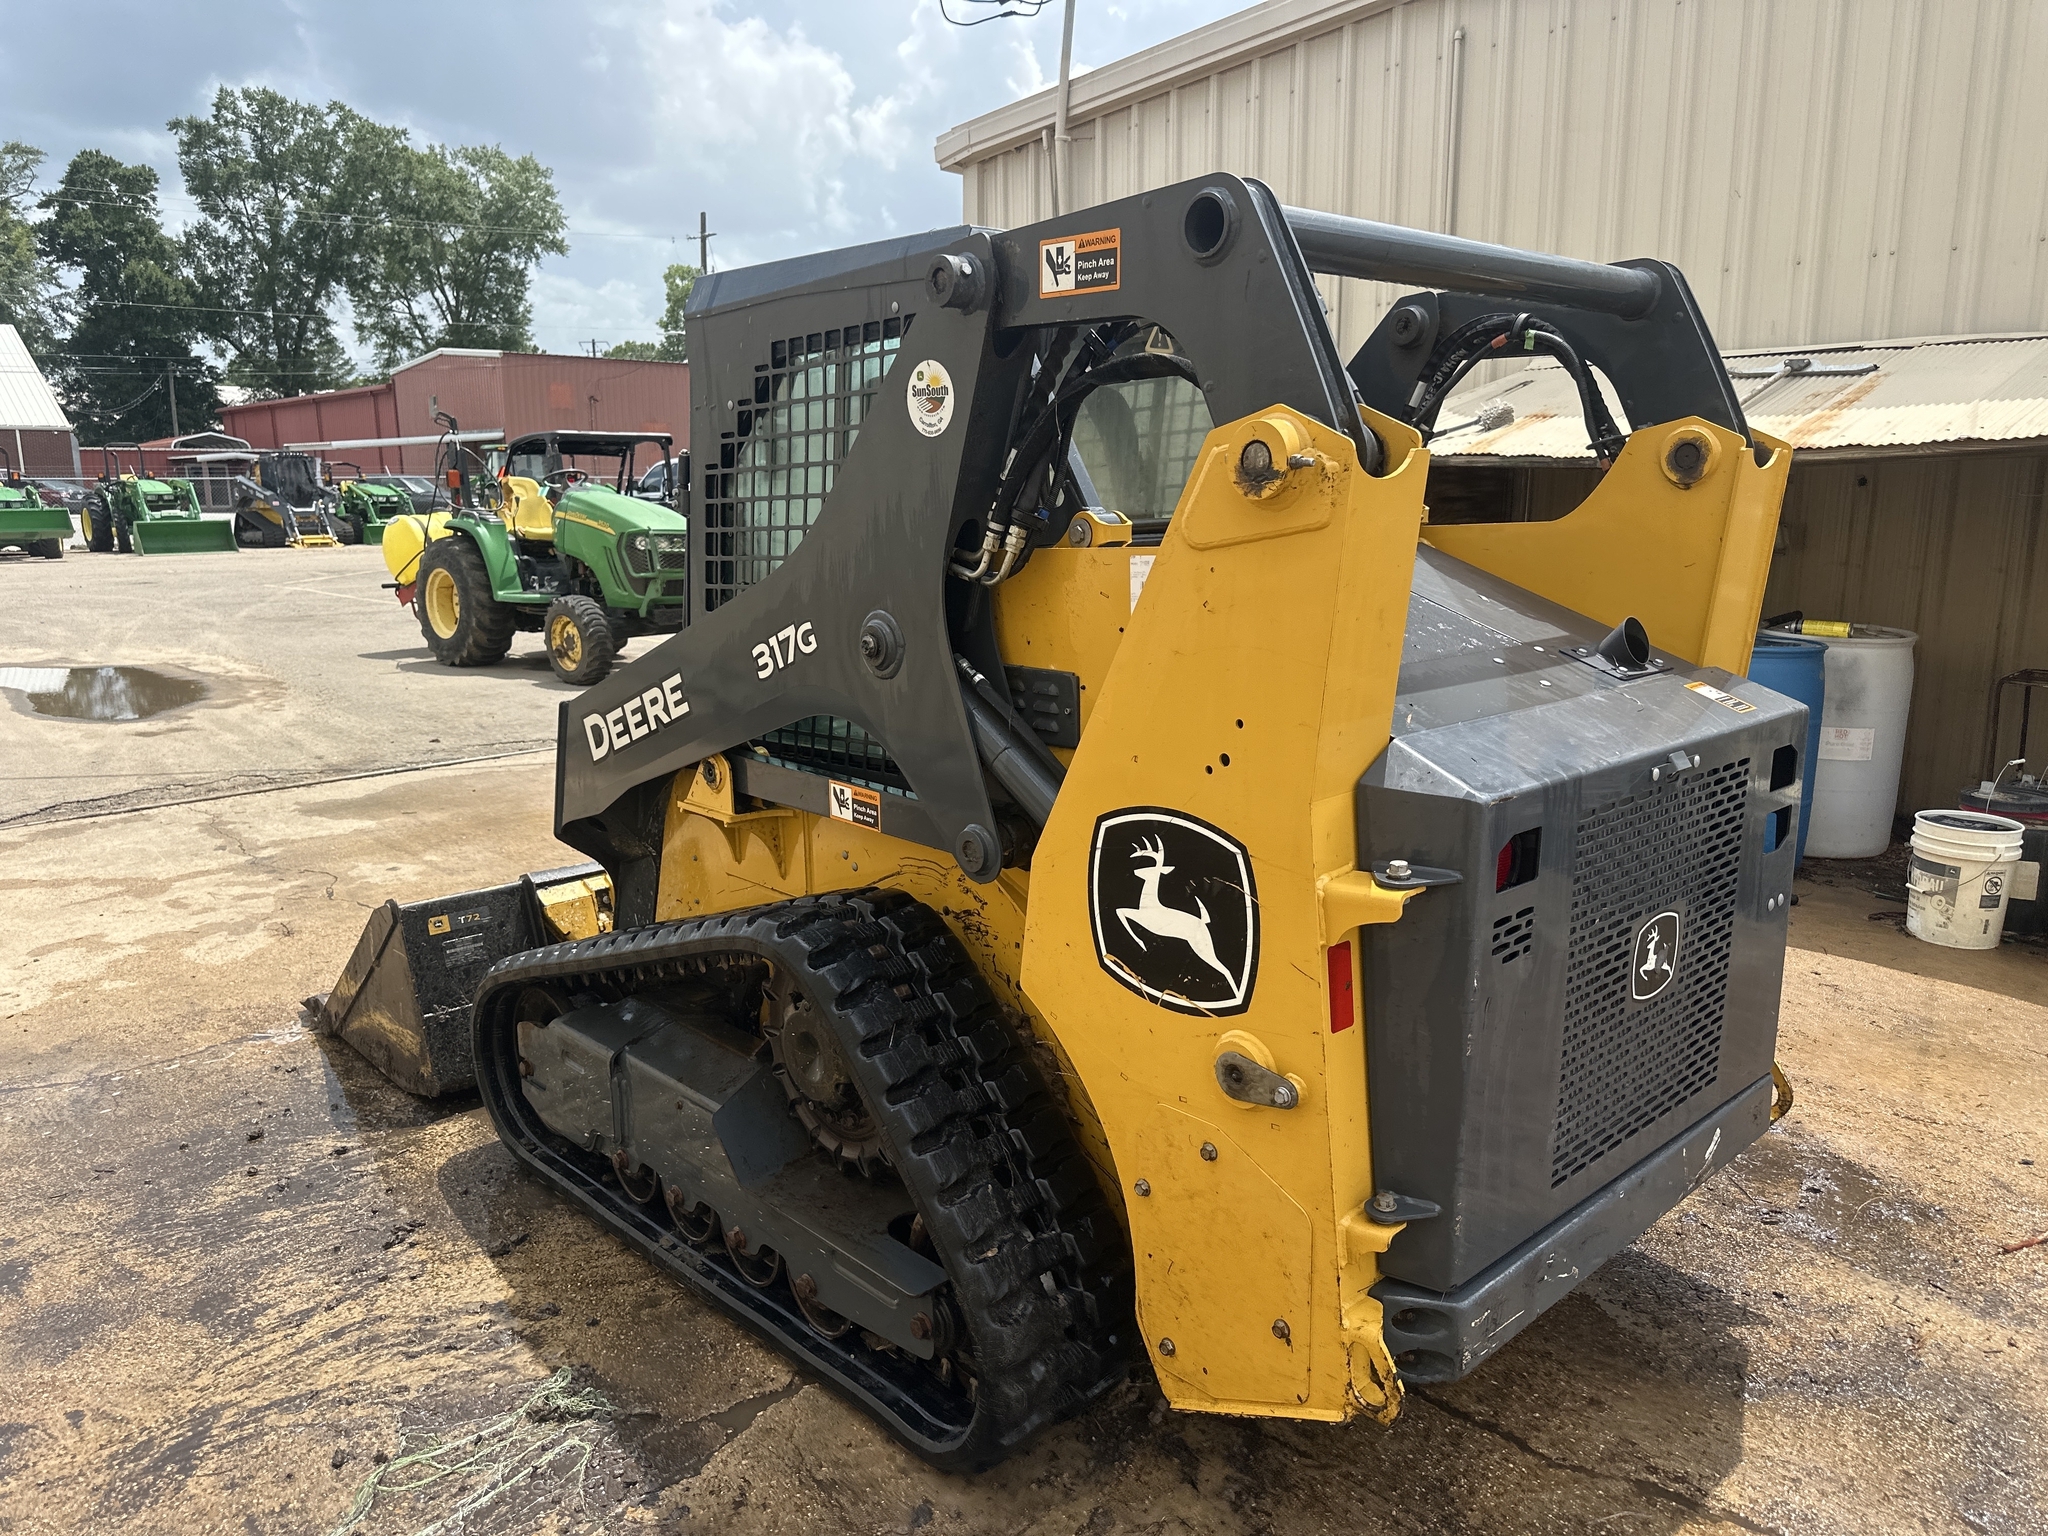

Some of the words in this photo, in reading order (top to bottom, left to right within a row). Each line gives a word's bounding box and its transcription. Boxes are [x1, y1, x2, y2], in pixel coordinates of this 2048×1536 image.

[1084, 235, 1117, 248] WARNING
[1077, 259, 1097, 270] Pinch
[1098, 257, 1115, 267] Area
[1077, 273, 1093, 282] Keep
[1093, 271, 1110, 280] Away
[911, 383, 949, 398] SunSouth
[751, 621, 818, 680] 317G
[583, 672, 690, 762] DEERE
[853, 803, 867, 813] Pinch
[866, 807, 877, 816] Area
[853, 812, 864, 821] Keep
[863, 815, 875, 824] Away
[457, 913, 481, 924] T72
